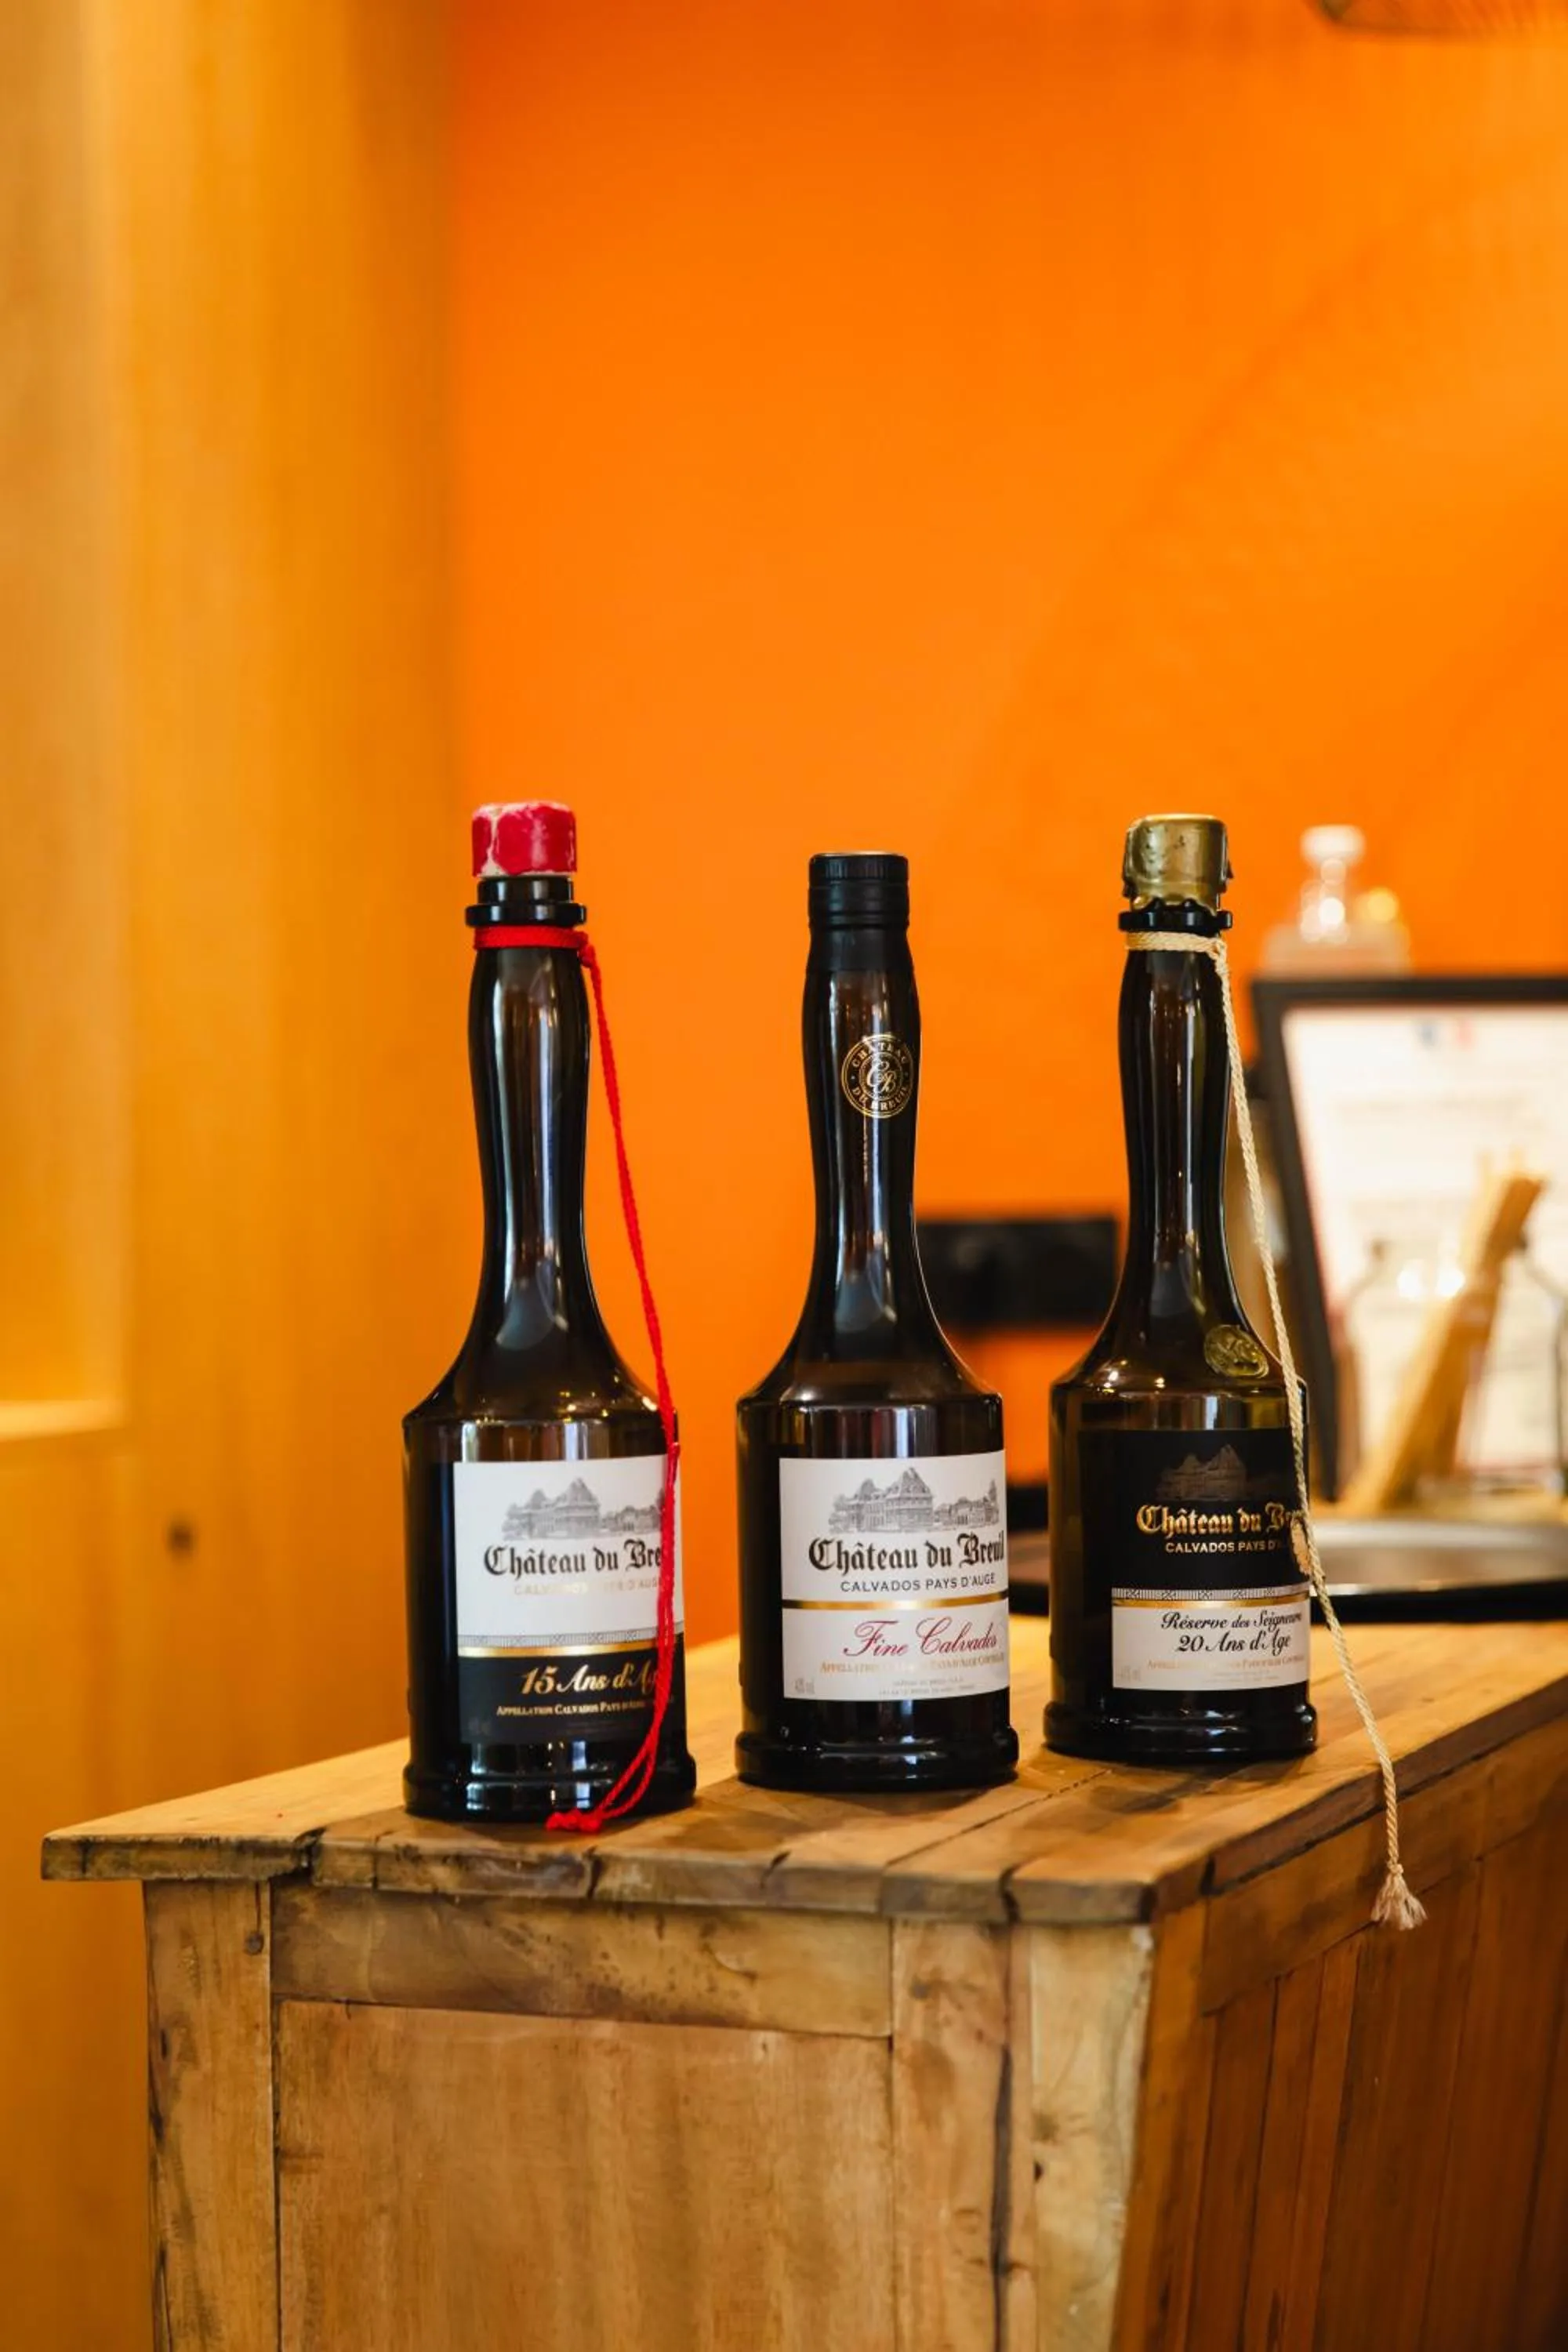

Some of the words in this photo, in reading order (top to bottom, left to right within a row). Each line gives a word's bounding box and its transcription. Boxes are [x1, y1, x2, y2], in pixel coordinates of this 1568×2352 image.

[1136, 1504, 1232, 1540] Château
[1239, 1508, 1261, 1533] du
[484, 1544, 586, 1579] Château
[595, 1548, 619, 1571] du
[624, 1539, 662, 1572] Bre
[809, 1537, 919, 1576] Château
[925, 1540, 953, 1568] du
[957, 1530, 1005, 1569] Breuil
[1166, 1542, 1235, 1553] CALVADOS
[1238, 1540, 1266, 1552] PAYS
[840, 1580, 920, 1592] CALVADOS
[926, 1577, 957, 1590] PAYS
[960, 1573, 996, 1587] D'AUGE
[1160, 1611, 1228, 1630] Réserve
[1231, 1613, 1250, 1629] des
[843, 1620, 909, 1657] Fine
[916, 1617, 997, 1655] Calvados
[1177, 1634, 1204, 1652] 20
[1205, 1630, 1246, 1652] Ans
[520, 1664, 559, 1694] 15
[556, 1664, 608, 1693] Ans
